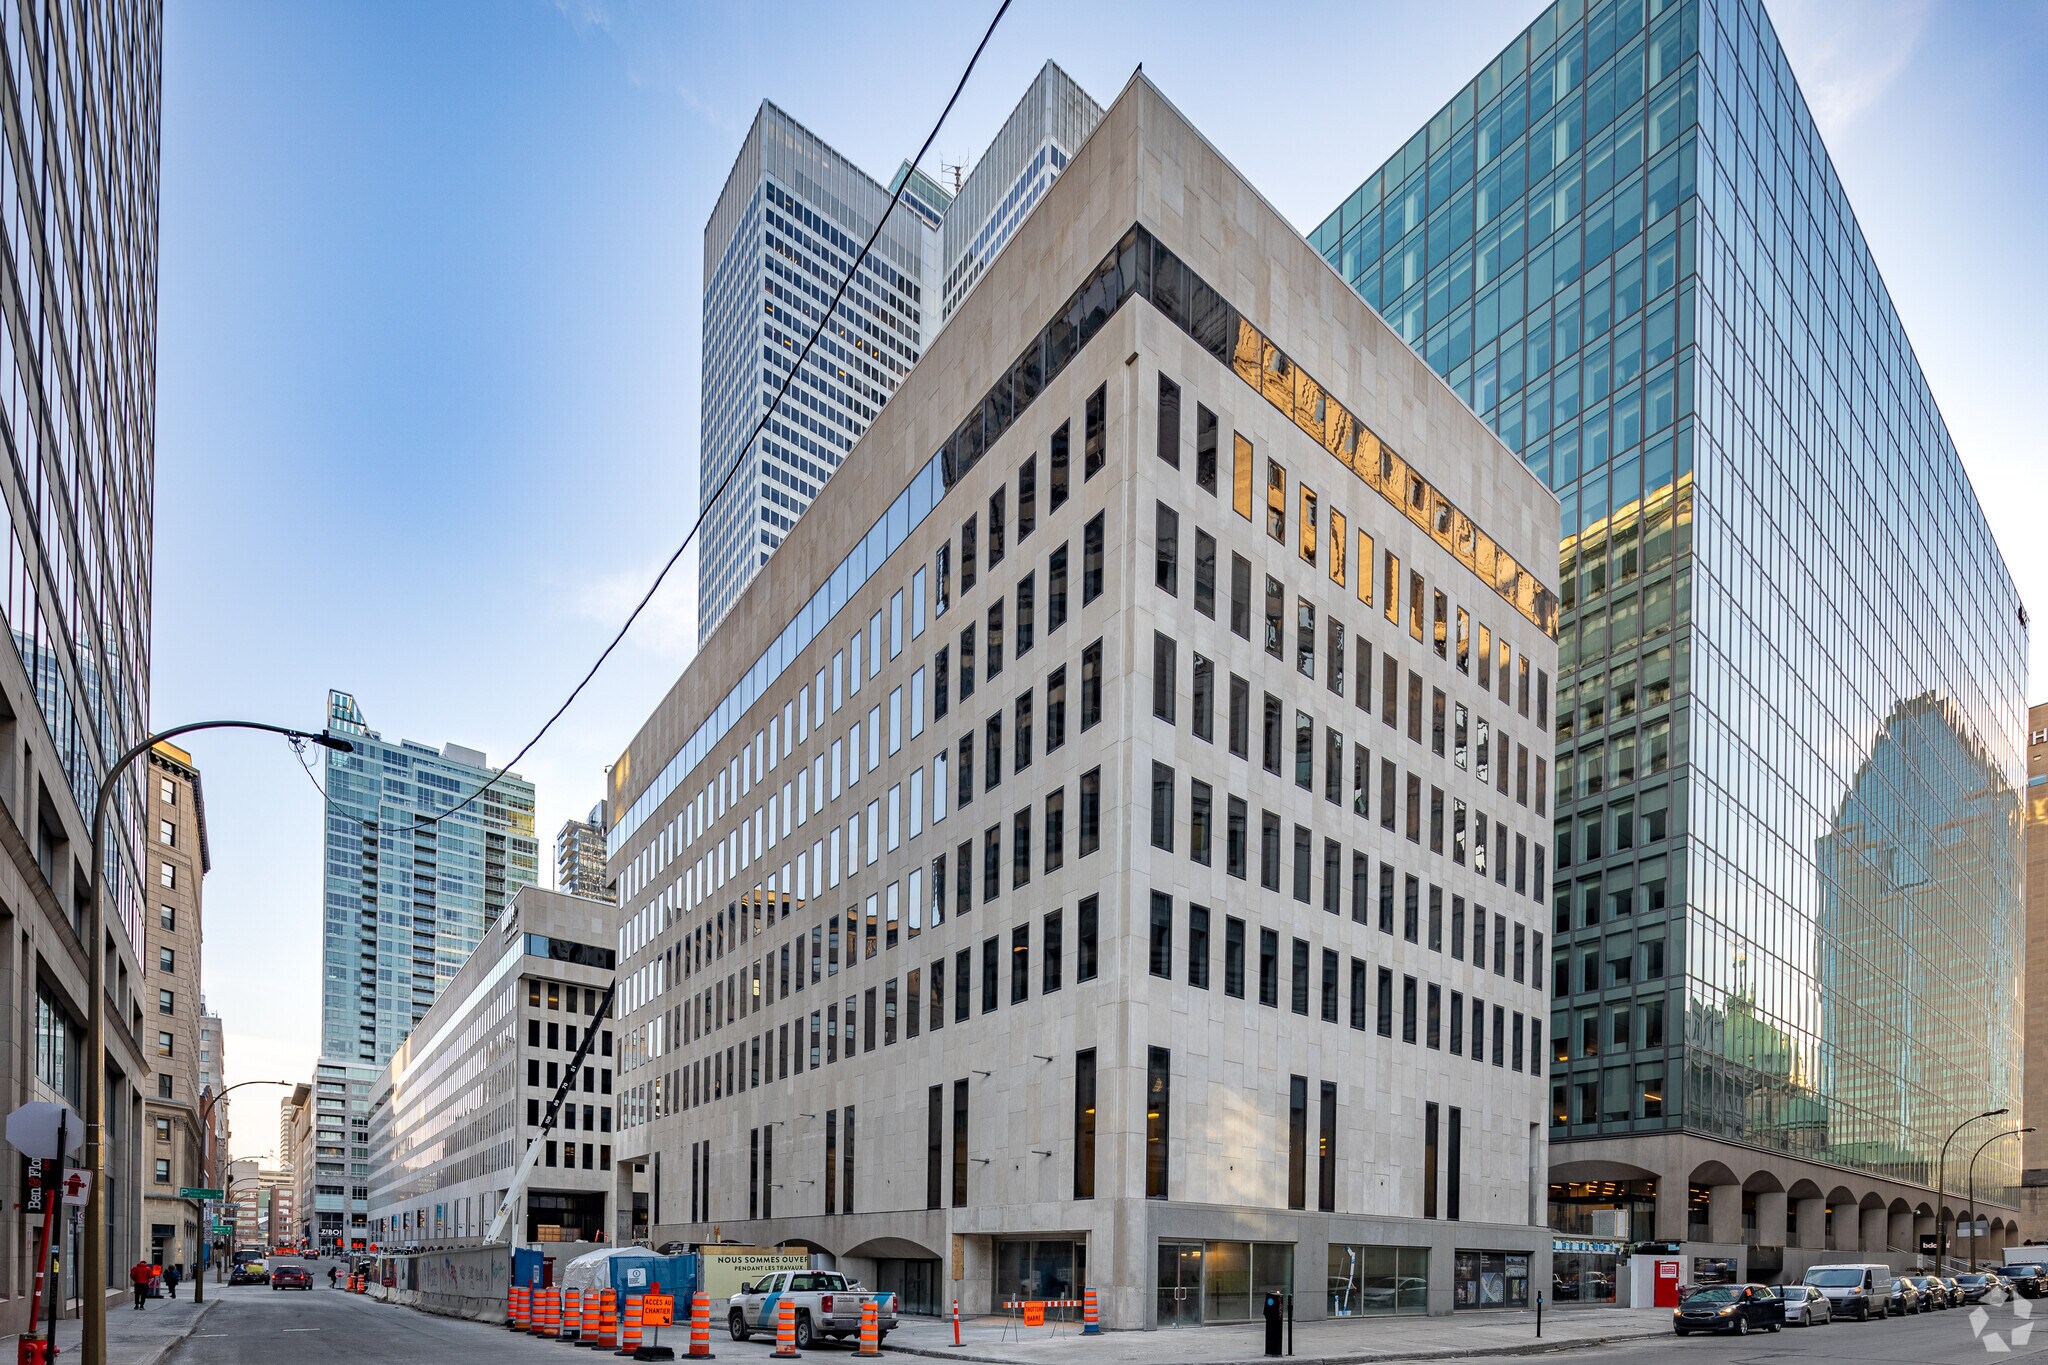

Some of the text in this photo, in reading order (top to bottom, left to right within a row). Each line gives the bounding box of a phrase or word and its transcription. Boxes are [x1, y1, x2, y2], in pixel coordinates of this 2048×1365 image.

[717, 1256, 742, 1264] NOUS
[744, 1256, 780, 1264] SOMMES
[644, 1298, 663, 1306] ACCÈS
[645, 1307, 671, 1315] CHANTIER
